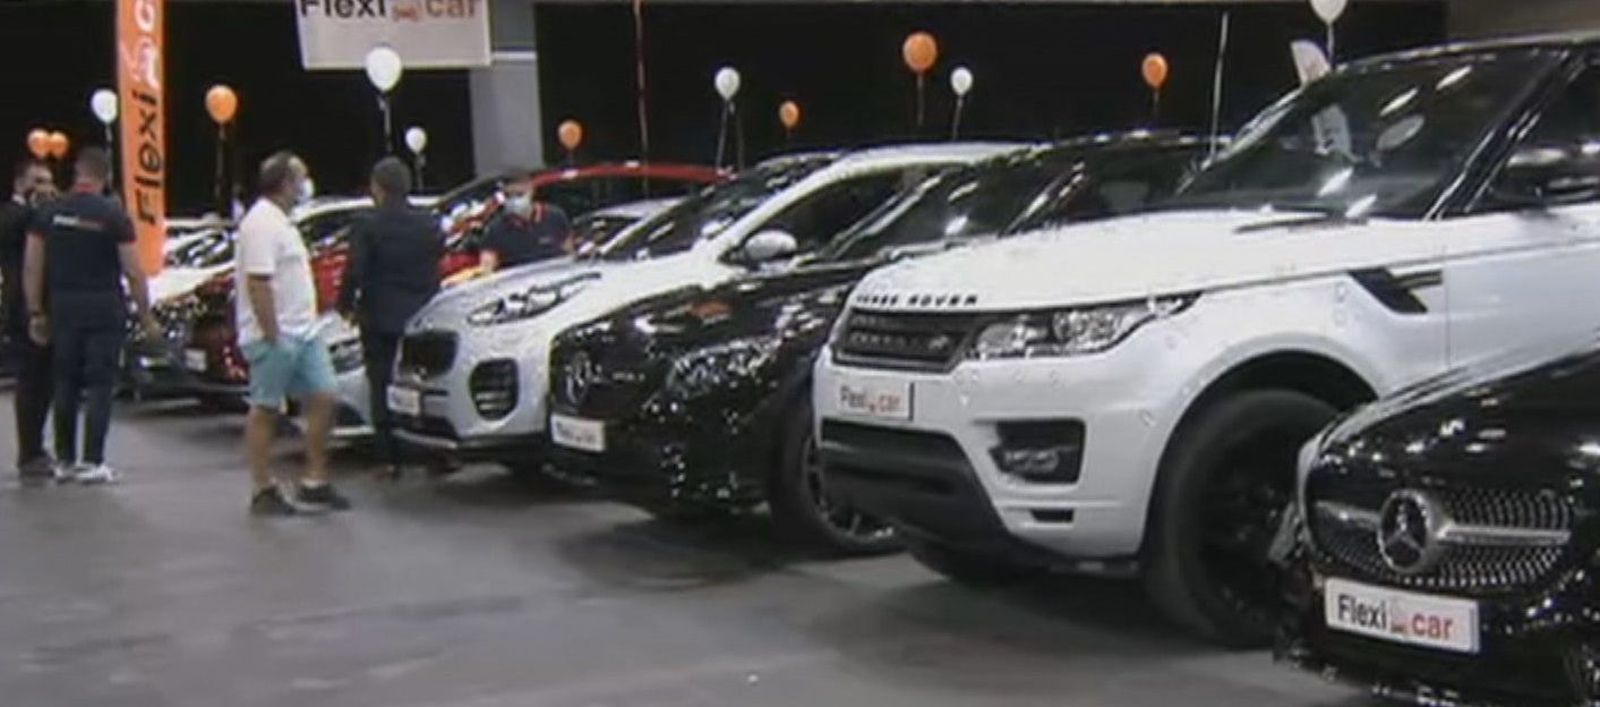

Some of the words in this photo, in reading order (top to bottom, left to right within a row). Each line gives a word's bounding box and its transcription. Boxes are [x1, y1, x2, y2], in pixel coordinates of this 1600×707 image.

[300, 0, 386, 18] Flexi
[425, 0, 476, 18] car
[132, 89, 162, 226] Flexi
[856, 294, 899, 306] NGE
[1337, 594, 1387, 630] Flexi
[1411, 612, 1453, 639] car
